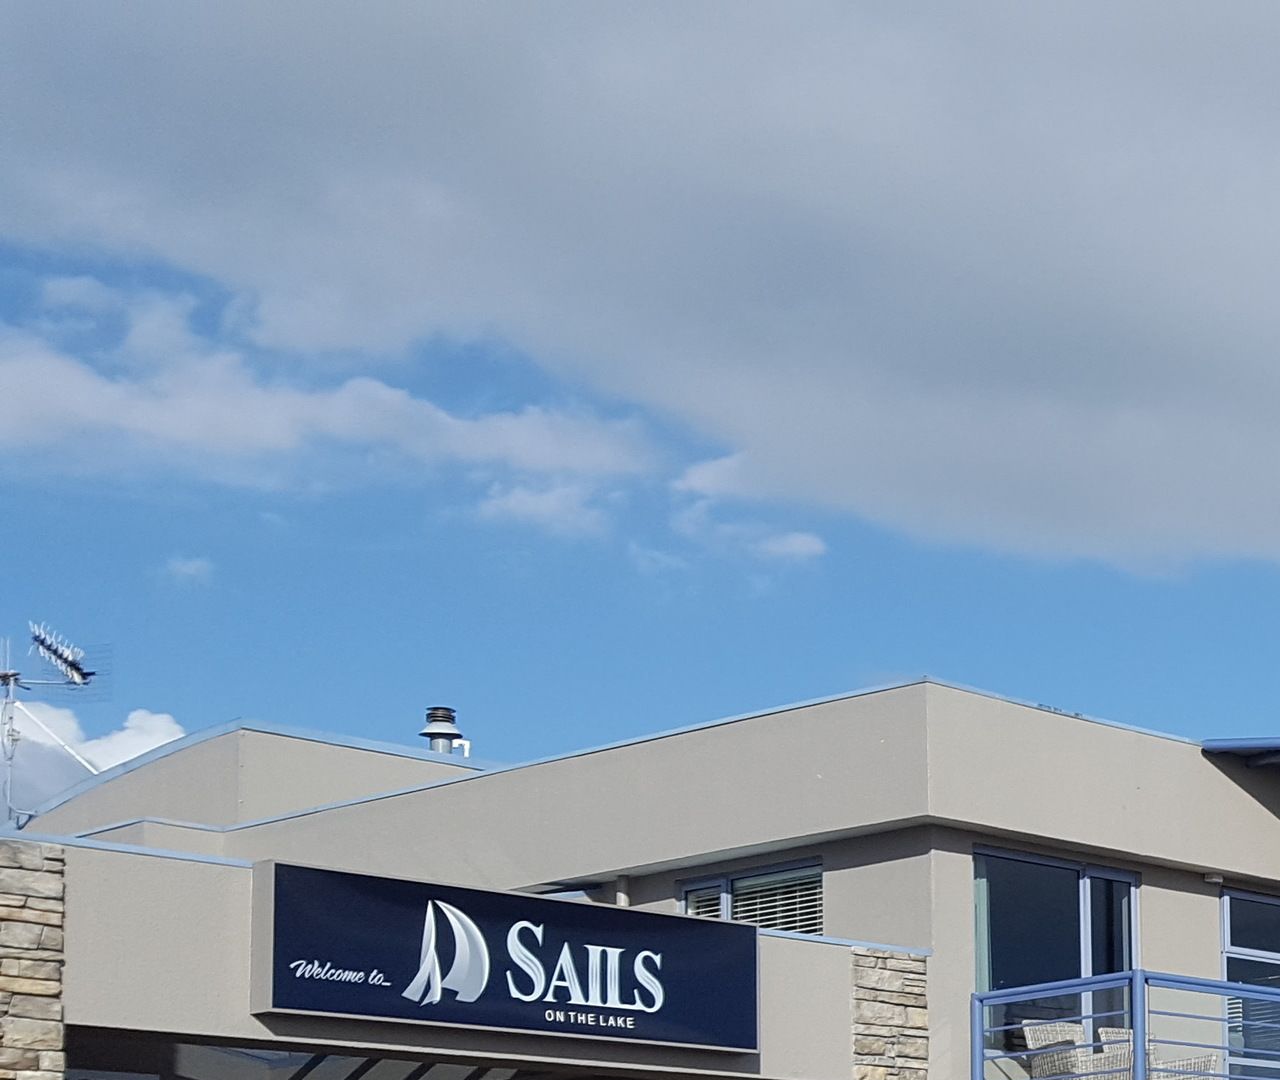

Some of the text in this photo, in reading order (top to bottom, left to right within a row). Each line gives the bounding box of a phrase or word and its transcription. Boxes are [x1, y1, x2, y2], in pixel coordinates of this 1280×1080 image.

[289, 959, 365, 983] Welcome
[545, 1010, 635, 1028] ON THE LAKE
